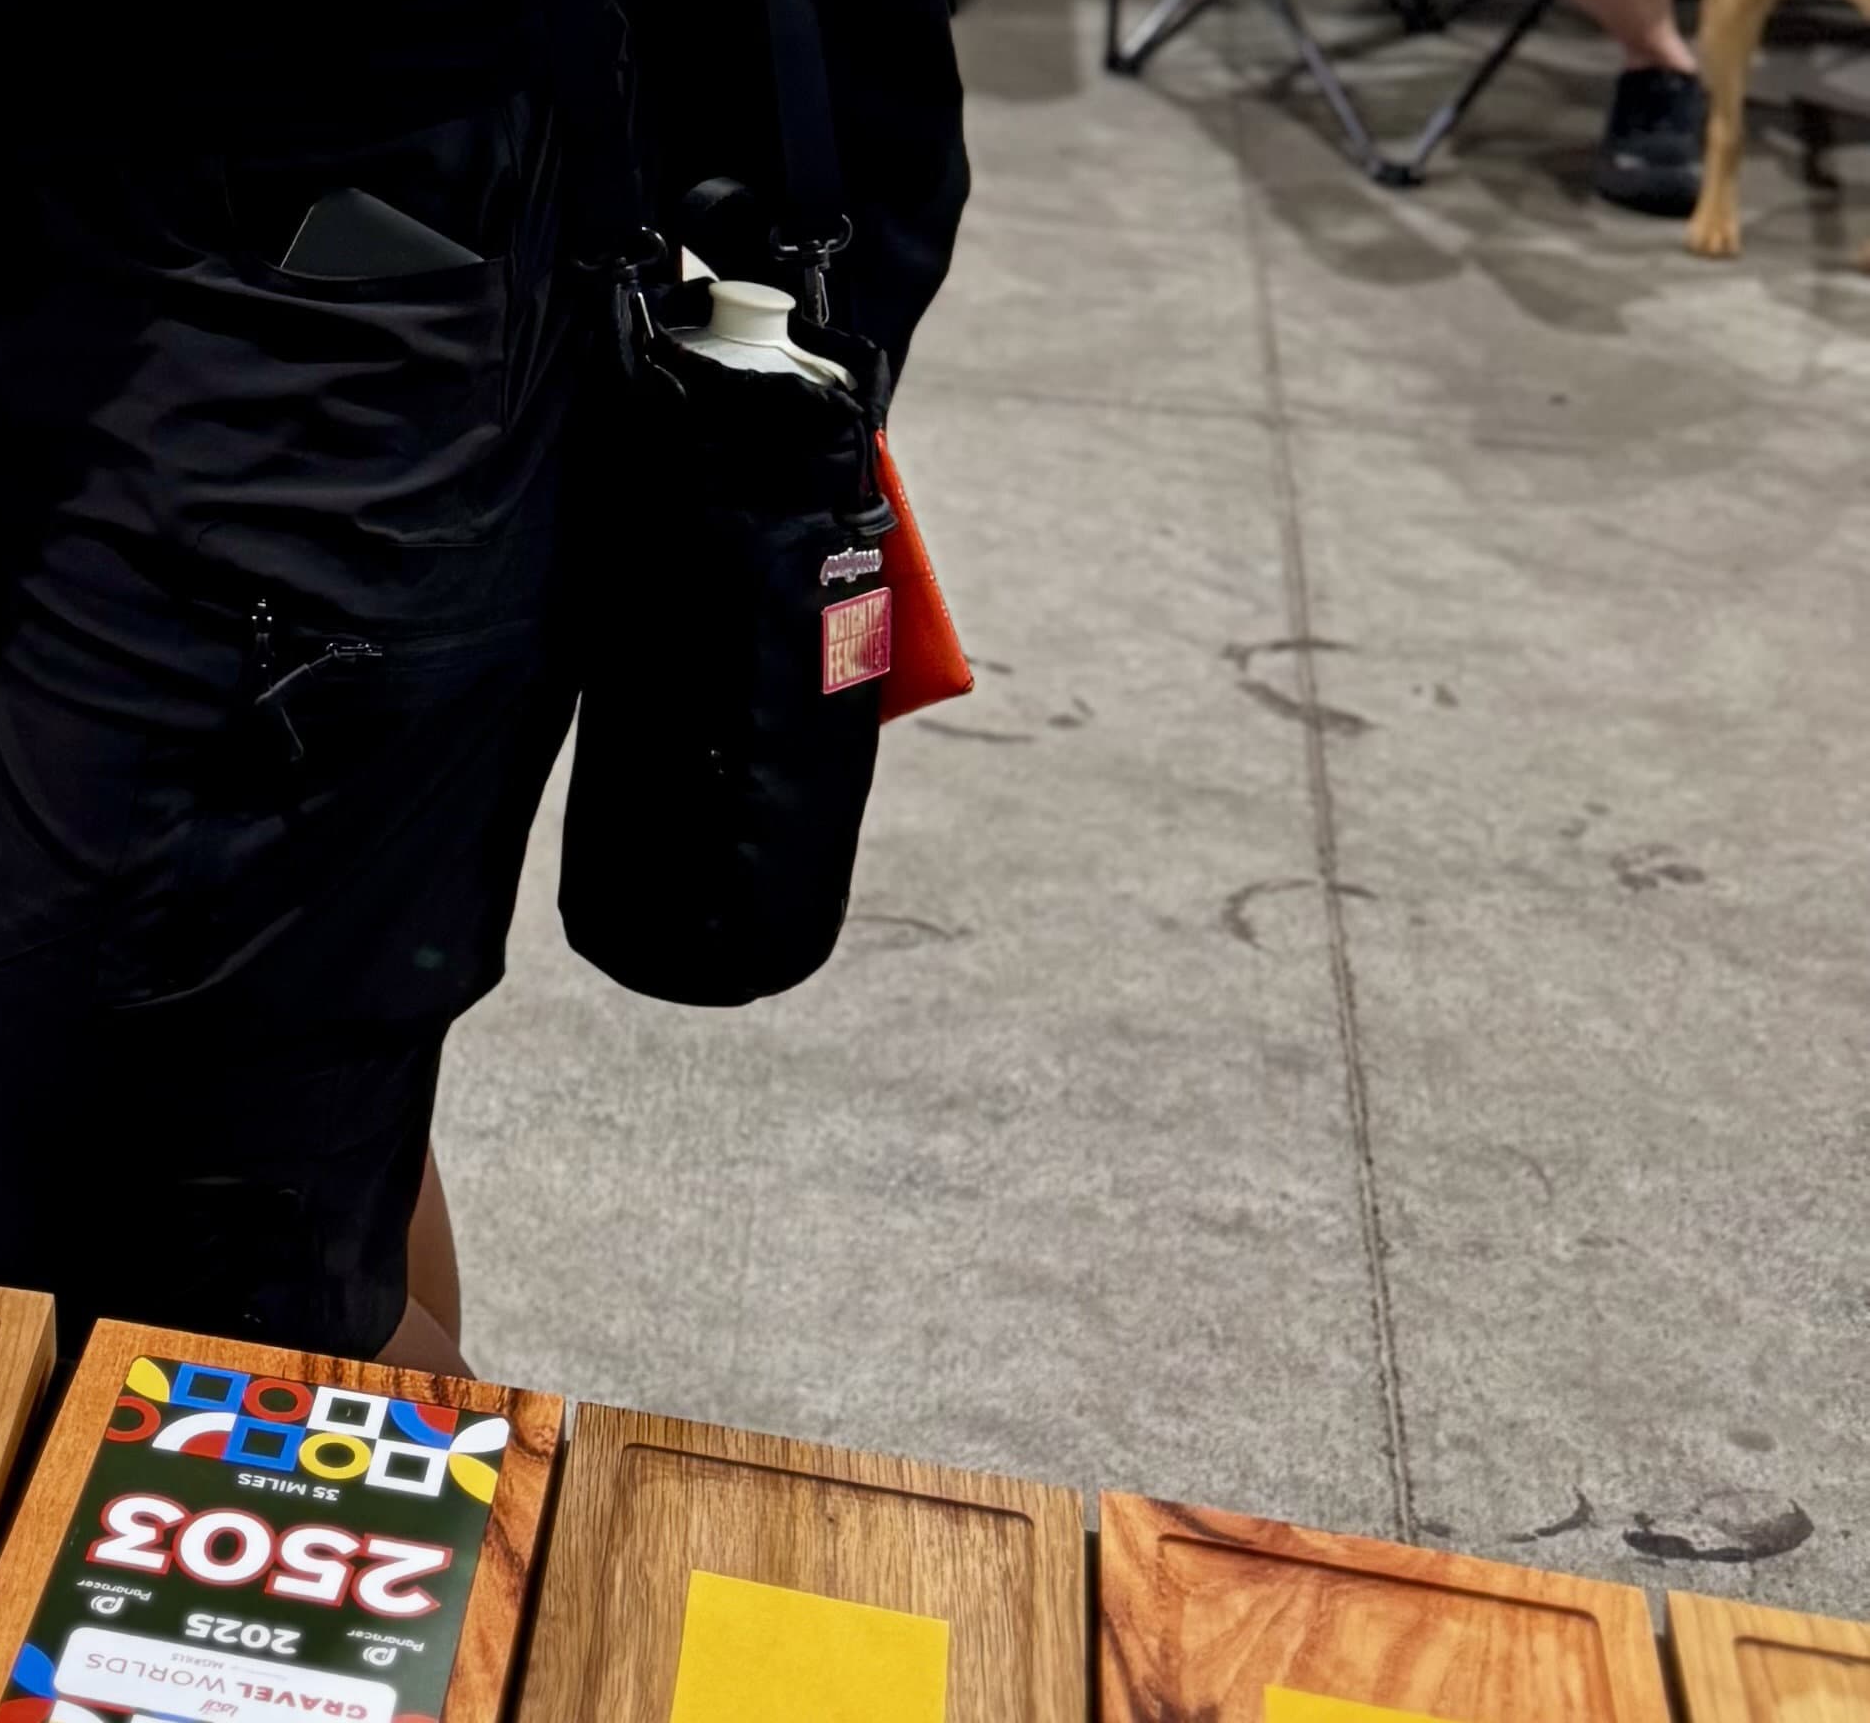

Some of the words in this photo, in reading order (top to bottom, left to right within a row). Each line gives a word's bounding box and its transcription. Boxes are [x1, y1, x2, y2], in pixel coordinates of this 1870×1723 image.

[236, 1470, 309, 1497] MILES
[311, 1484, 341, 1503] 35
[84, 1491, 454, 1619] 2503
[75, 1577, 154, 1603] Panaracer
[184, 1611, 302, 1656] 2025
[345, 1627, 426, 1654] Panaracer
[84, 1652, 228, 1696] WORLDS
[235, 1681, 370, 1722] GRAVEL
